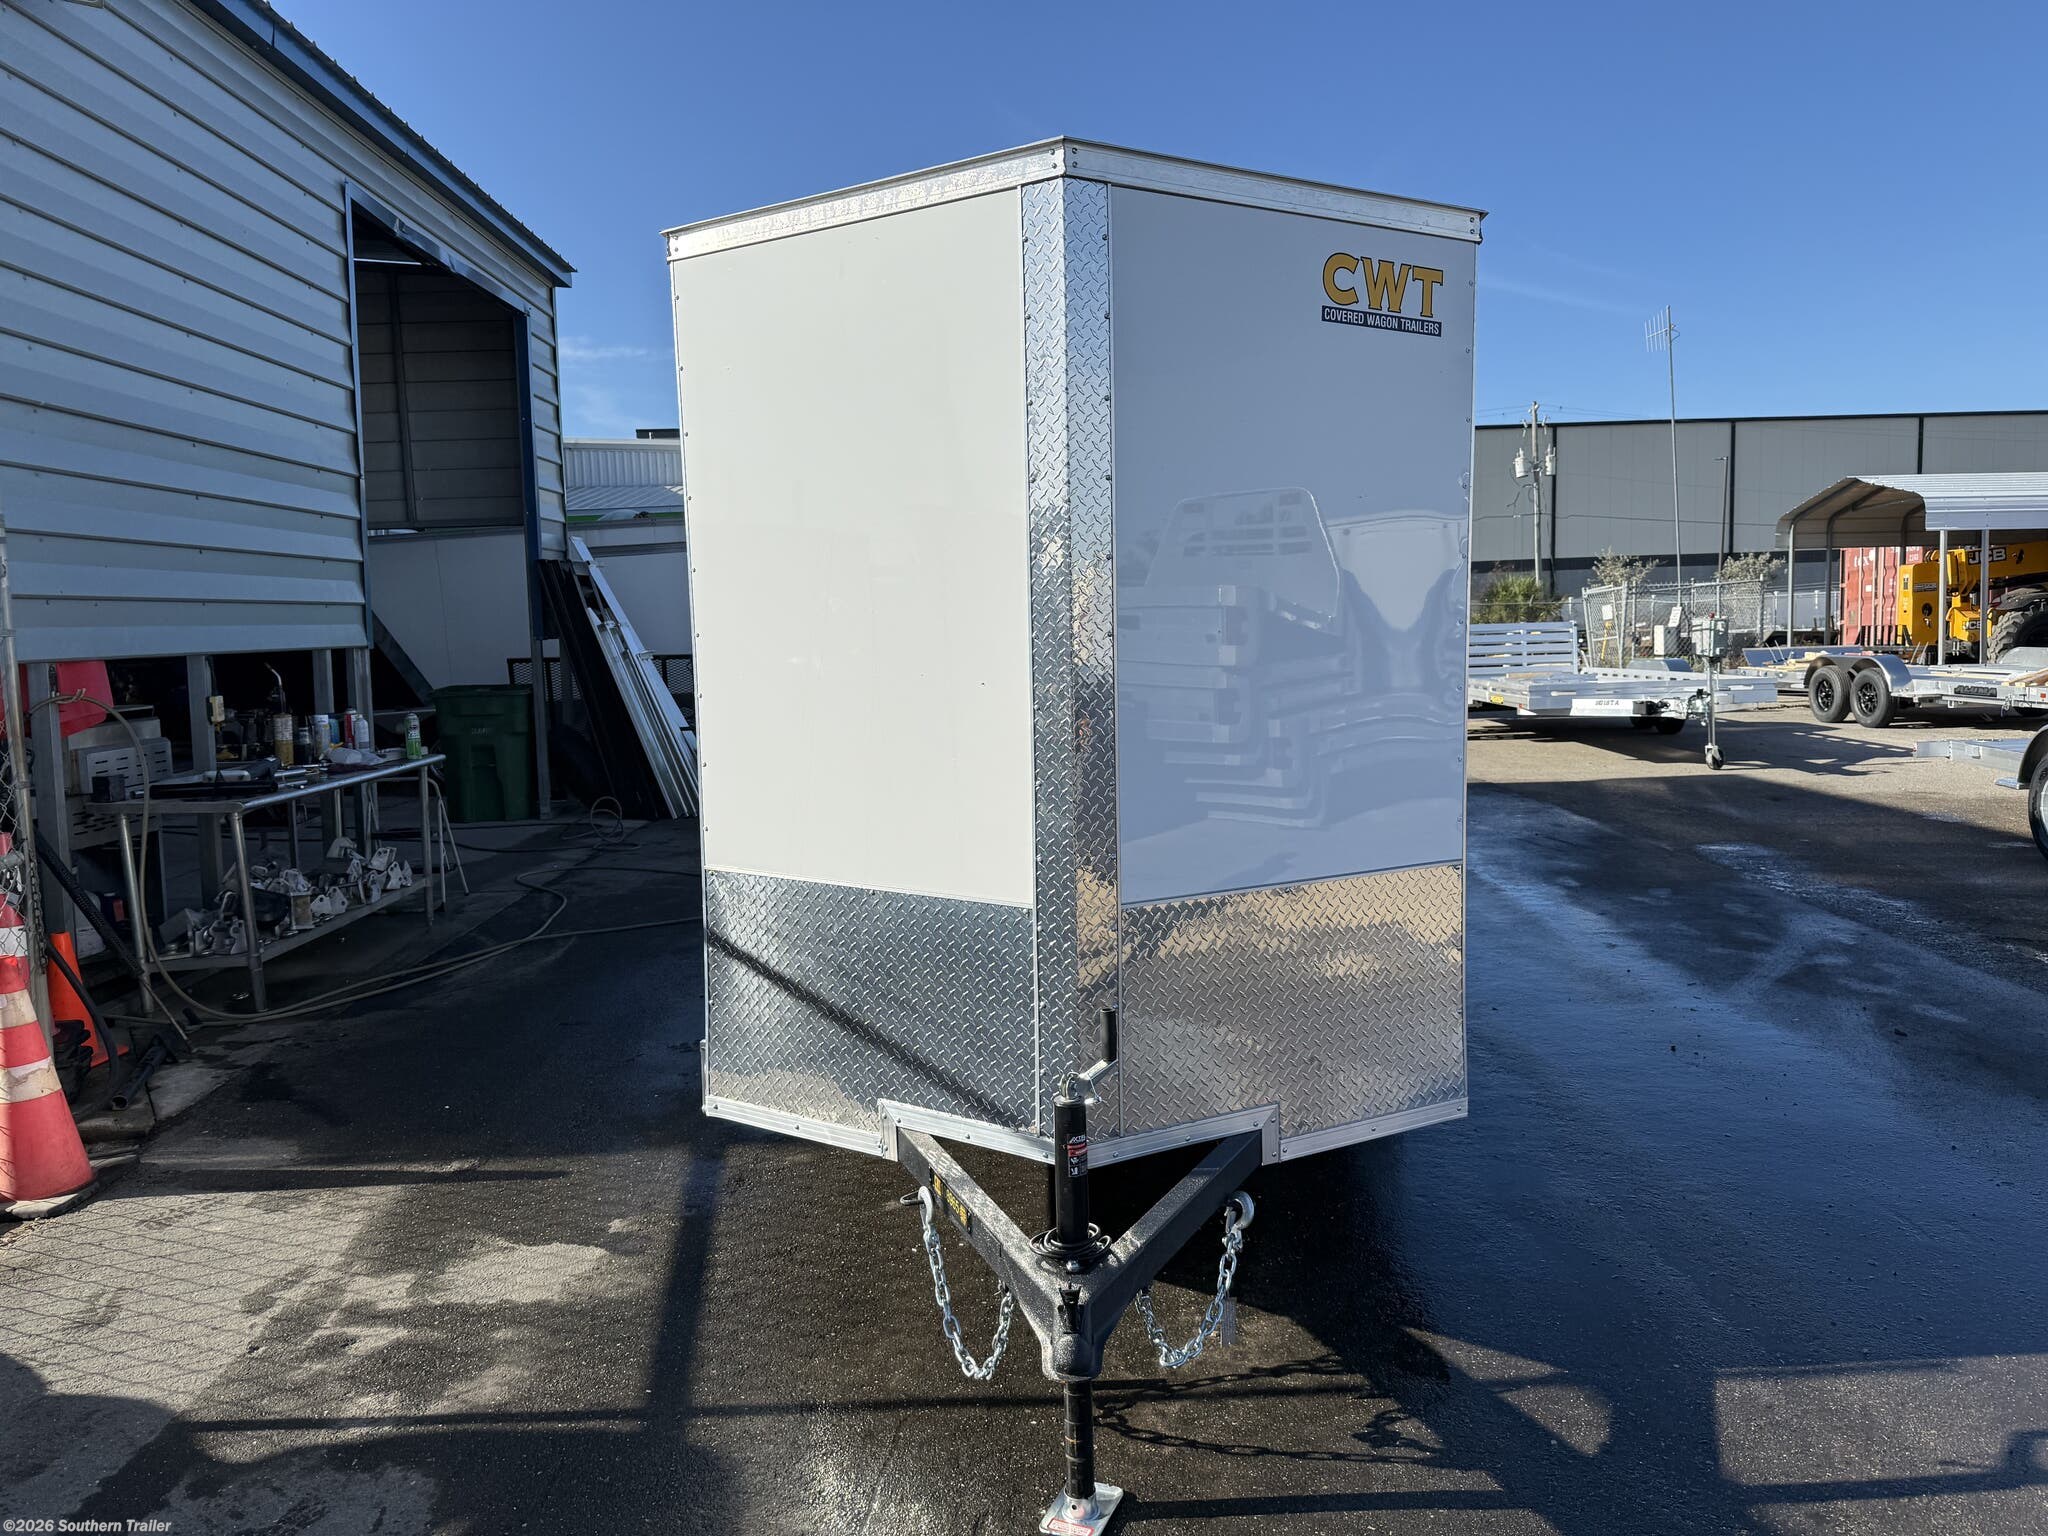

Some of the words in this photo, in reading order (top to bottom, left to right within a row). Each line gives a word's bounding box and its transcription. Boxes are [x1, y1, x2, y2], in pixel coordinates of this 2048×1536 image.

[1323, 252, 1443, 318] CWT
[1324, 308, 1364, 324] COVERED
[1366, 313, 1398, 329] WAGON
[1400, 319, 1440, 335] TRAILERS
